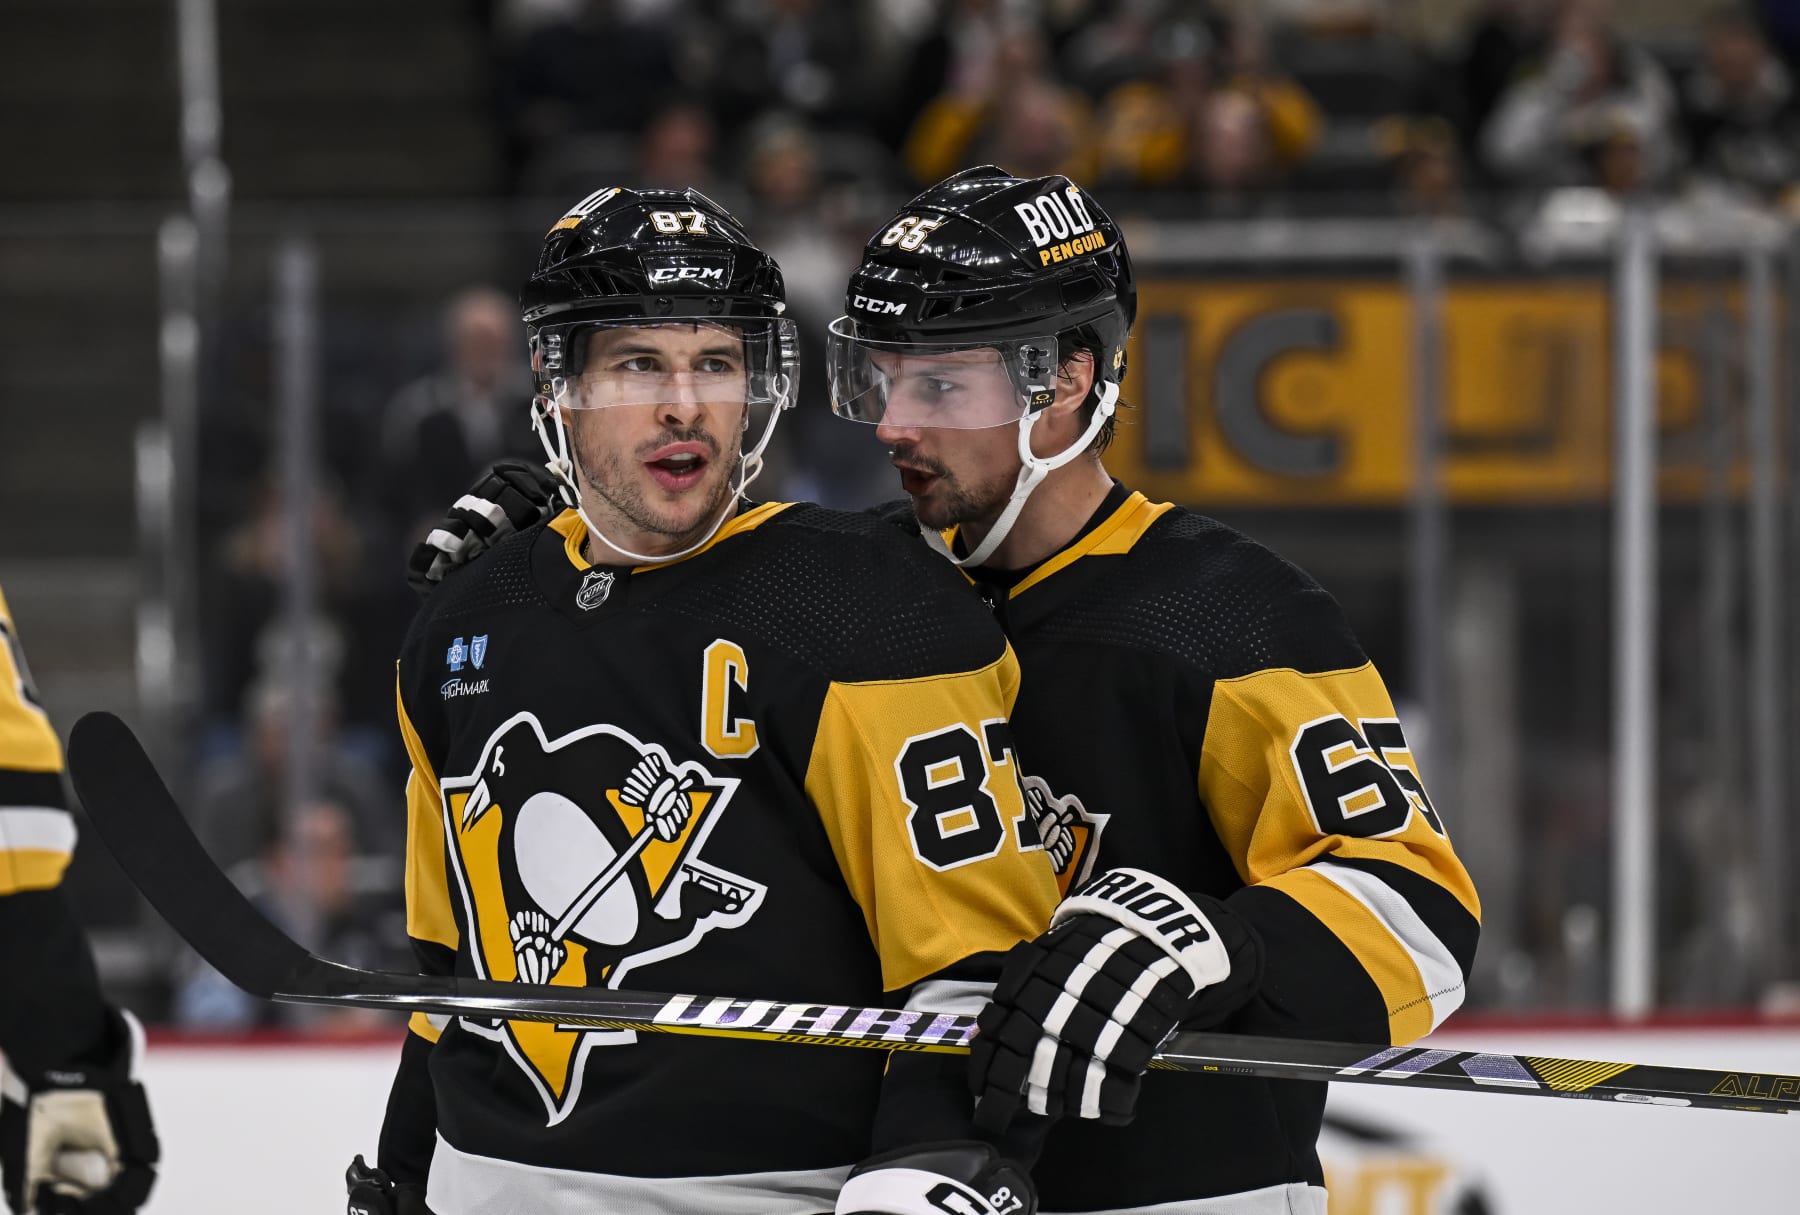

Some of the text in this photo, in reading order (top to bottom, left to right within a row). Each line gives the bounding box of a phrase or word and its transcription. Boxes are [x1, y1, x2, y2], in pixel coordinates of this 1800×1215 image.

[650, 211, 709, 235] 87
[881, 216, 942, 252] 65
[1014, 186, 1094, 248] BOLD
[1039, 231, 1107, 267] PENGUIN
[652, 267, 724, 280] CCM
[853, 294, 907, 316] CCM
[700, 638, 760, 760] C
[1289, 713, 1448, 840] 65
[894, 717, 1046, 873] 87
[1072, 872, 1210, 953] RIOR
[989, 1186, 1024, 1215] 87
